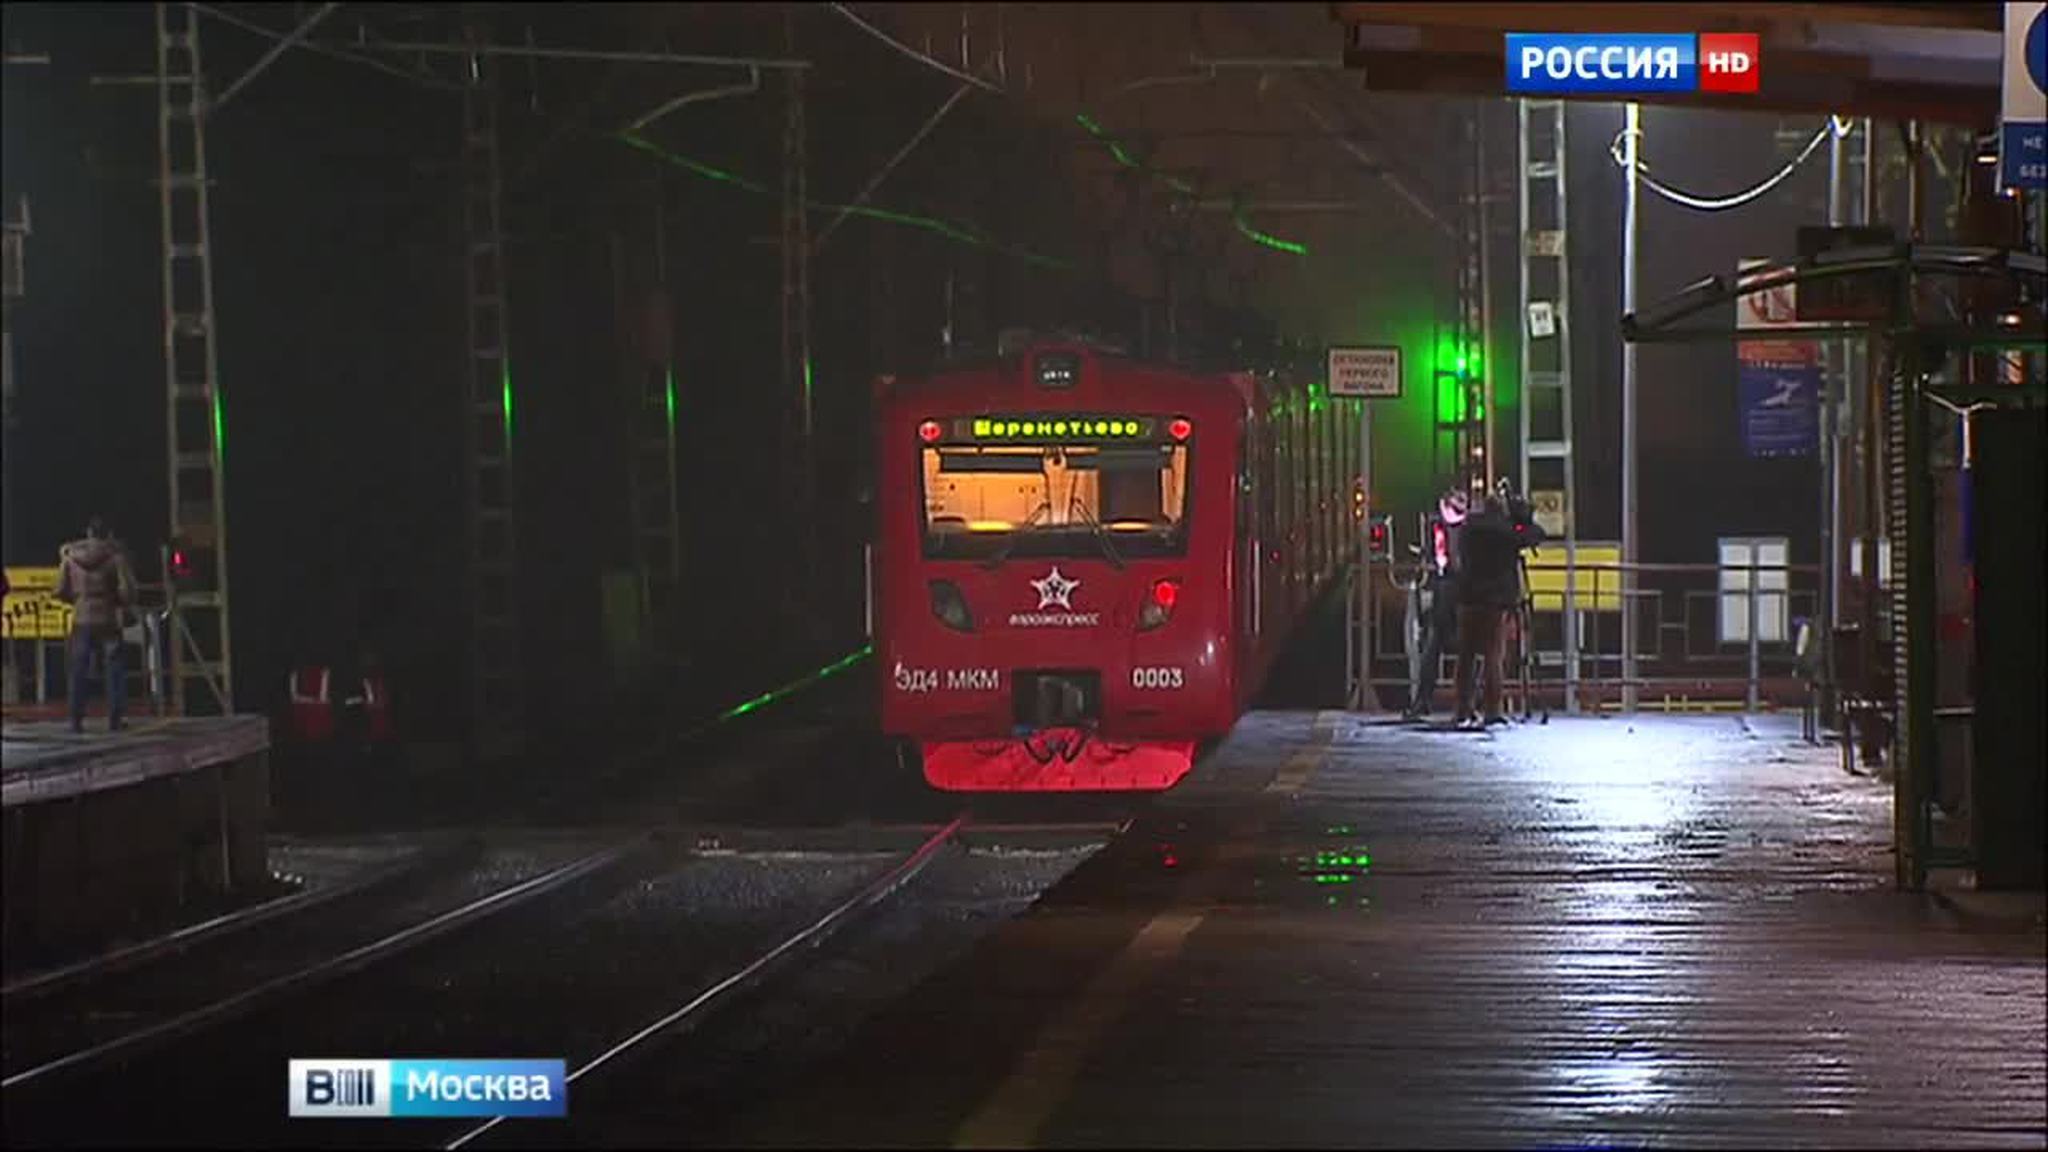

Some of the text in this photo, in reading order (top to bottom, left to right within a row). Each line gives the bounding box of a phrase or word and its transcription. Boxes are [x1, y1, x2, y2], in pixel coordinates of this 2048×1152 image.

[896, 668, 999, 693] ЭД4 МКМ
[1132, 667, 1183, 688] 0003
